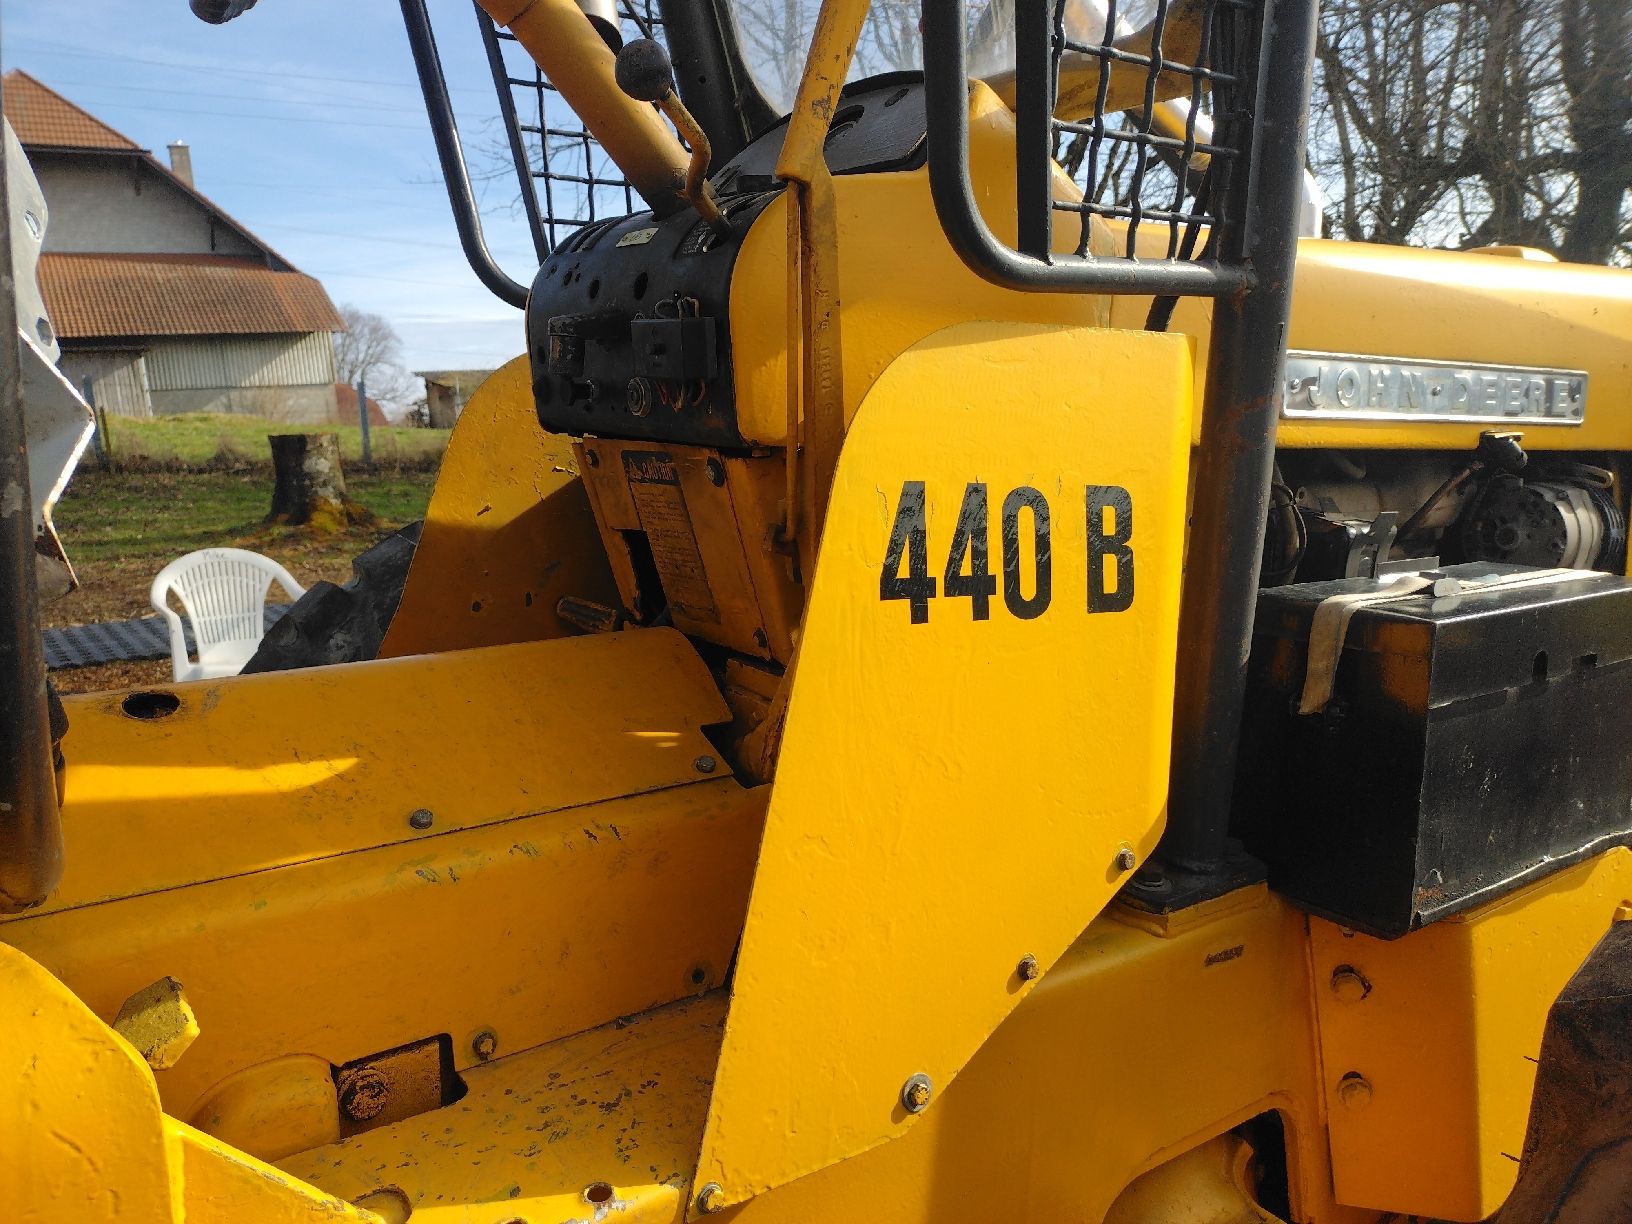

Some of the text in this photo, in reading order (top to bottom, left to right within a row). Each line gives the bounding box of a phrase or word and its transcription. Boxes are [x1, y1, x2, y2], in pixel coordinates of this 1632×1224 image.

[1307, 366, 1570, 417] JOHN DEERE
[879, 480, 1134, 624] 440 B
